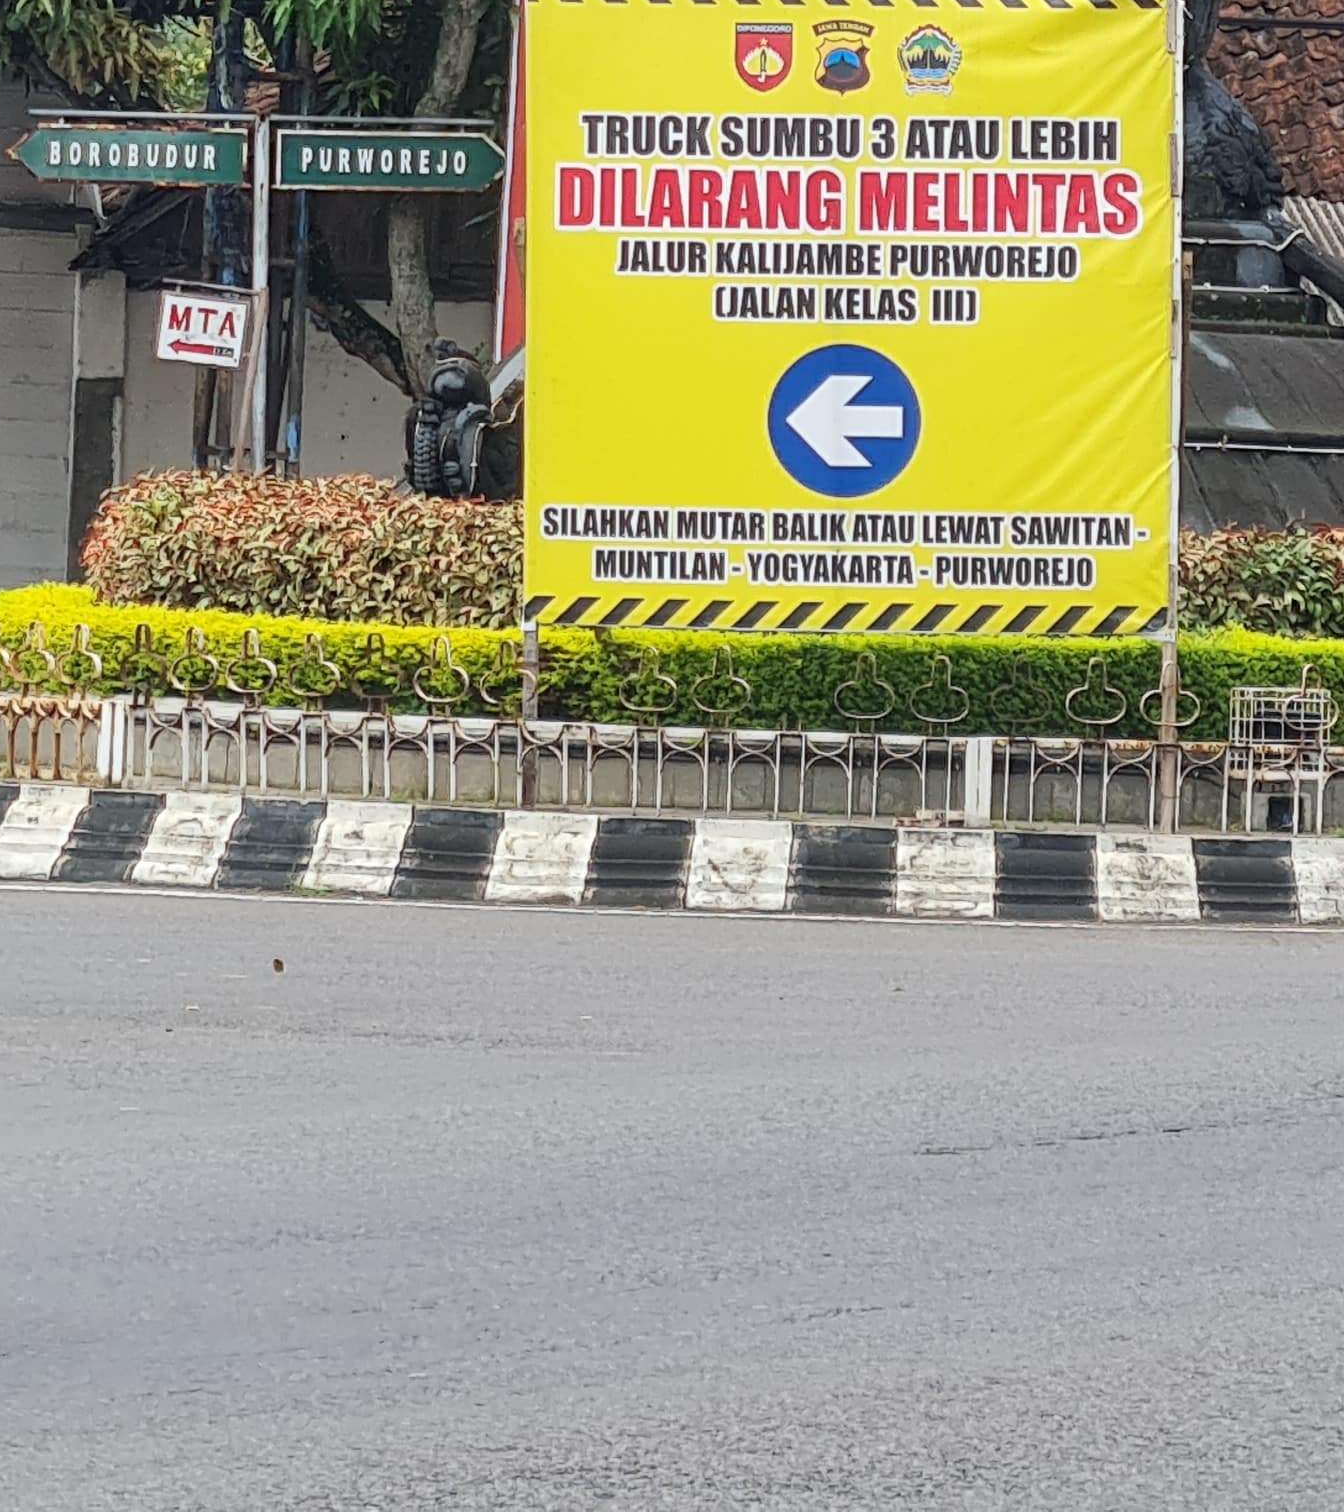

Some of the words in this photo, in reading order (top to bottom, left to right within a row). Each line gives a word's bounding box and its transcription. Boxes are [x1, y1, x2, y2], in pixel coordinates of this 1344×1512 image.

[48, 140, 217, 171] BOROBUDUR
[582, 115, 712, 157] TRUCK
[721, 116, 858, 159] SUMBU
[870, 120, 896, 159] 3
[905, 119, 1000, 160] ATAU
[1010, 120, 1118, 161] LEBIH
[300, 145, 468, 176] PURWOREJO
[558, 167, 842, 231] DILARANG
[858, 171, 1140, 234] MELINTAS
[617, 241, 707, 275] JALUR
[715, 241, 882, 277] KALIJAMBE
[889, 245, 1077, 279] PURWOREJO
[167, 303, 237, 339] MTA
[714, 286, 816, 322] (JALAN
[824, 288, 917, 322] KELAS
[931, 289, 978, 324] III)
[543, 506, 668, 540] SILAHKAN
[676, 508, 765, 541] MUTAR
[771, 511, 846, 543] BALIK
[853, 514, 916, 544] ATAU
[922, 515, 1003, 545] LEWAT
[1010, 516, 1130, 546] SAWITAN
[594, 549, 726, 581] MUNTILAN
[747, 552, 914, 585] YOGYAKARTA
[936, 555, 1093, 587] PURWOREJO
